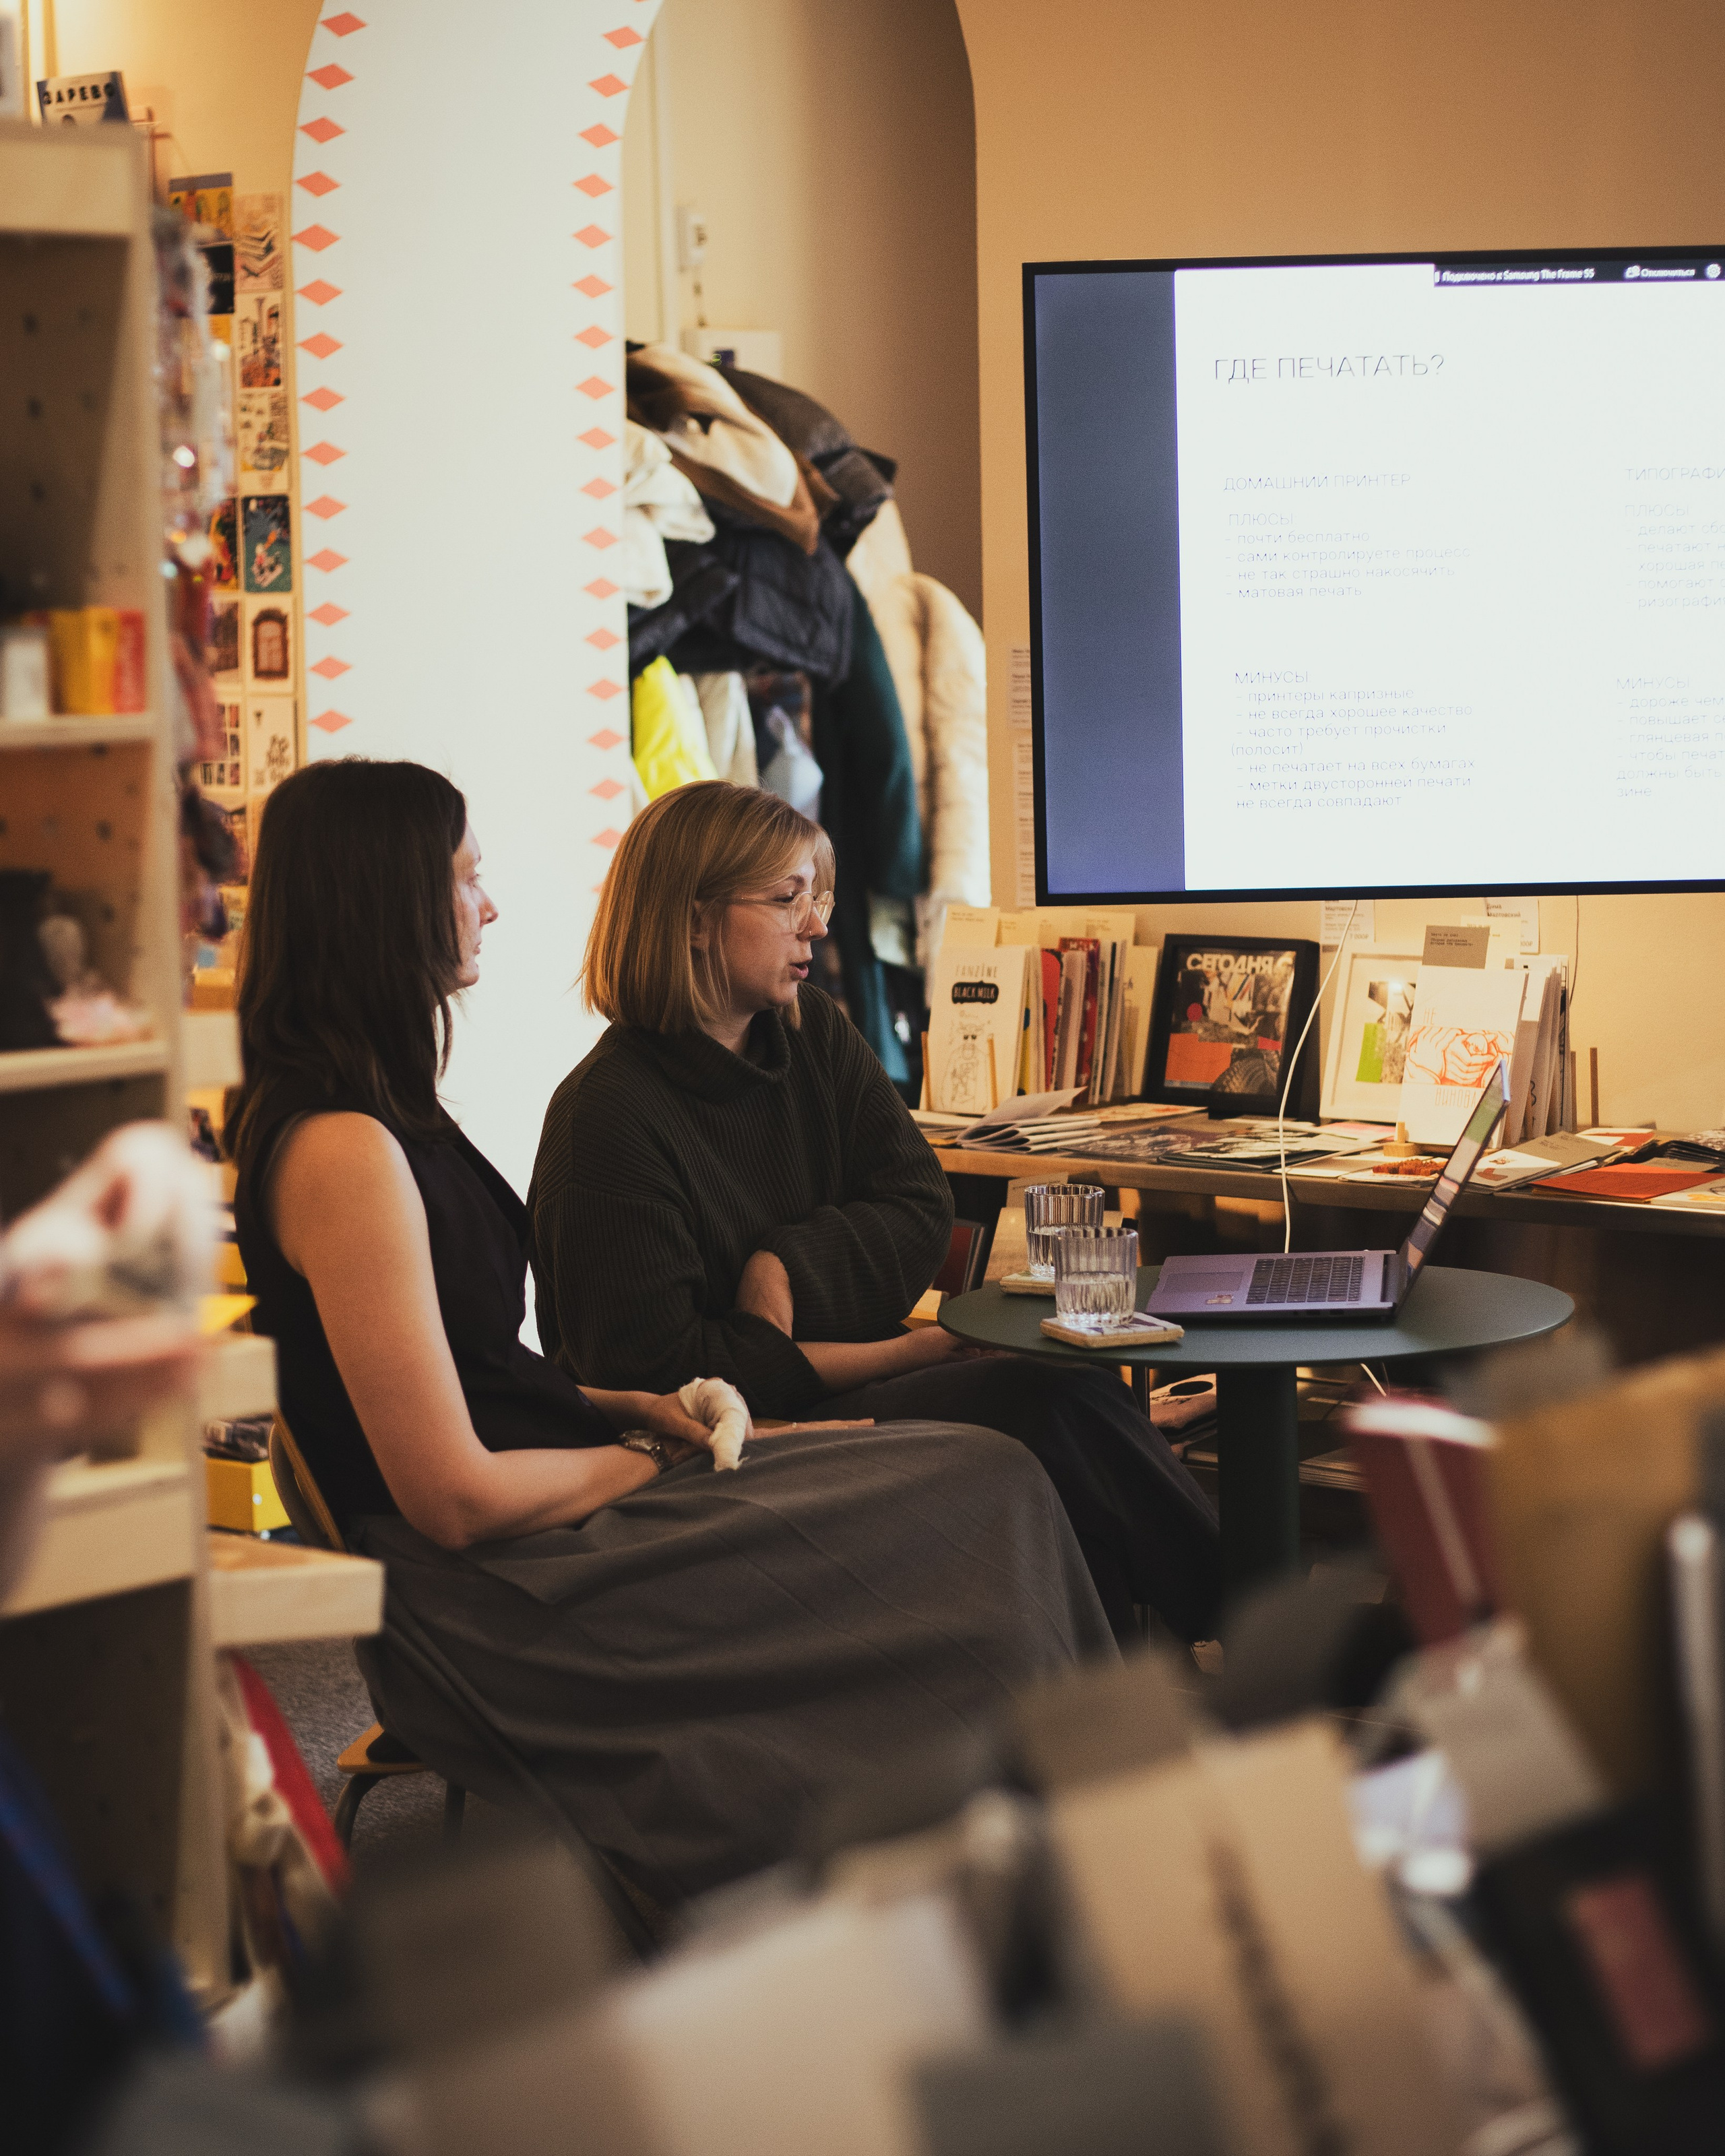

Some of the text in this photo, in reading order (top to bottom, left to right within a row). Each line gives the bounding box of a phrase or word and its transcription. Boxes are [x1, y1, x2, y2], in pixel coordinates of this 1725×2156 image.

[1443, 271, 1495, 282] Подключено
[1503, 270, 1540, 281] Samsung
[1541, 269, 1557, 279] The
[1558, 268, 1583, 279] Frame
[1640, 268, 1695, 278] Отключиться
[1214, 353, 1445, 385] ГДЕ ПЕЧАТАТЬ?
[1222, 472, 1411, 493] ДОМАШНИЙ ПРИНТЕР
[1237, 530, 1370, 544] почти бесплатно
[1637, 524, 1696, 538] делают
[1637, 542, 1712, 553] печатают
[1237, 548, 1471, 565] сами контролируете процесс
[1238, 566, 1455, 583] не так страшно накосячить
[1638, 561, 1705, 574] хорошая
[1637, 578, 1715, 590] помогают
[1238, 586, 1362, 599] матовая печать
[1248, 689, 1414, 706] принтеры капризные
[1629, 696, 1724, 711] дороже чем
[1249, 705, 1473, 722] не всегда хорошее качество
[1629, 714, 1708, 726] повышает
[1249, 722, 1446, 740] часто требует прочистки
[1629, 732, 1710, 744] глянцевая
[1230, 741, 1303, 757] (полосит)
[1629, 747, 1676, 761] чтобы
[1249, 756, 1476, 774] не печатает на всех бумагах
[1615, 764, 1722, 782] должны быть
[1249, 777, 1471, 794] метки двусторонней печати
[1617, 787, 1653, 798] зине
[1236, 796, 1402, 811] не всегда совпадают
[1187, 953, 1274, 975] СЕГОДНЯ
[953, 986, 996, 1000] BLACK MILK
[1423, 1007, 1437, 1025] НЕ
